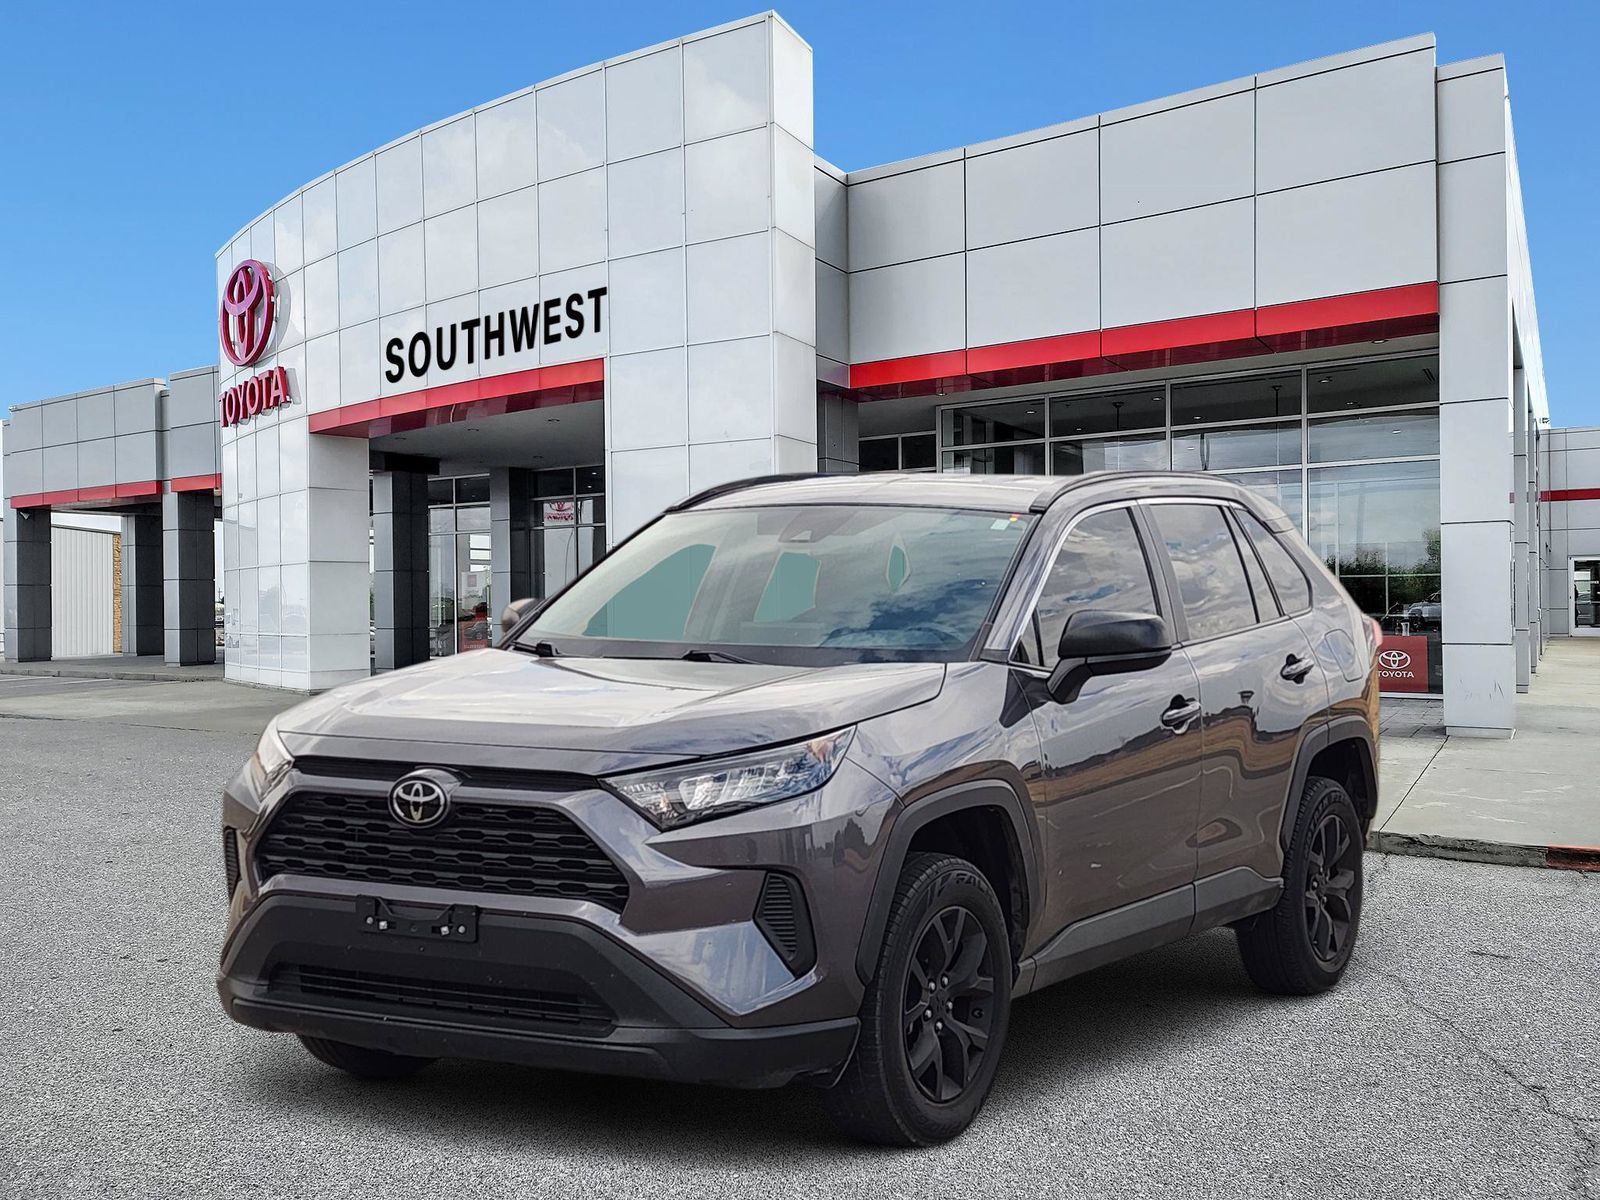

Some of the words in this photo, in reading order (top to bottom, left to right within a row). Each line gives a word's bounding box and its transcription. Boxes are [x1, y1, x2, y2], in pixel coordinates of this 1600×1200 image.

[385, 286, 607, 384] SOUTHWEST
[218, 366, 289, 428] TOYOTA
[1377, 670, 1415, 678] TOYOTA
